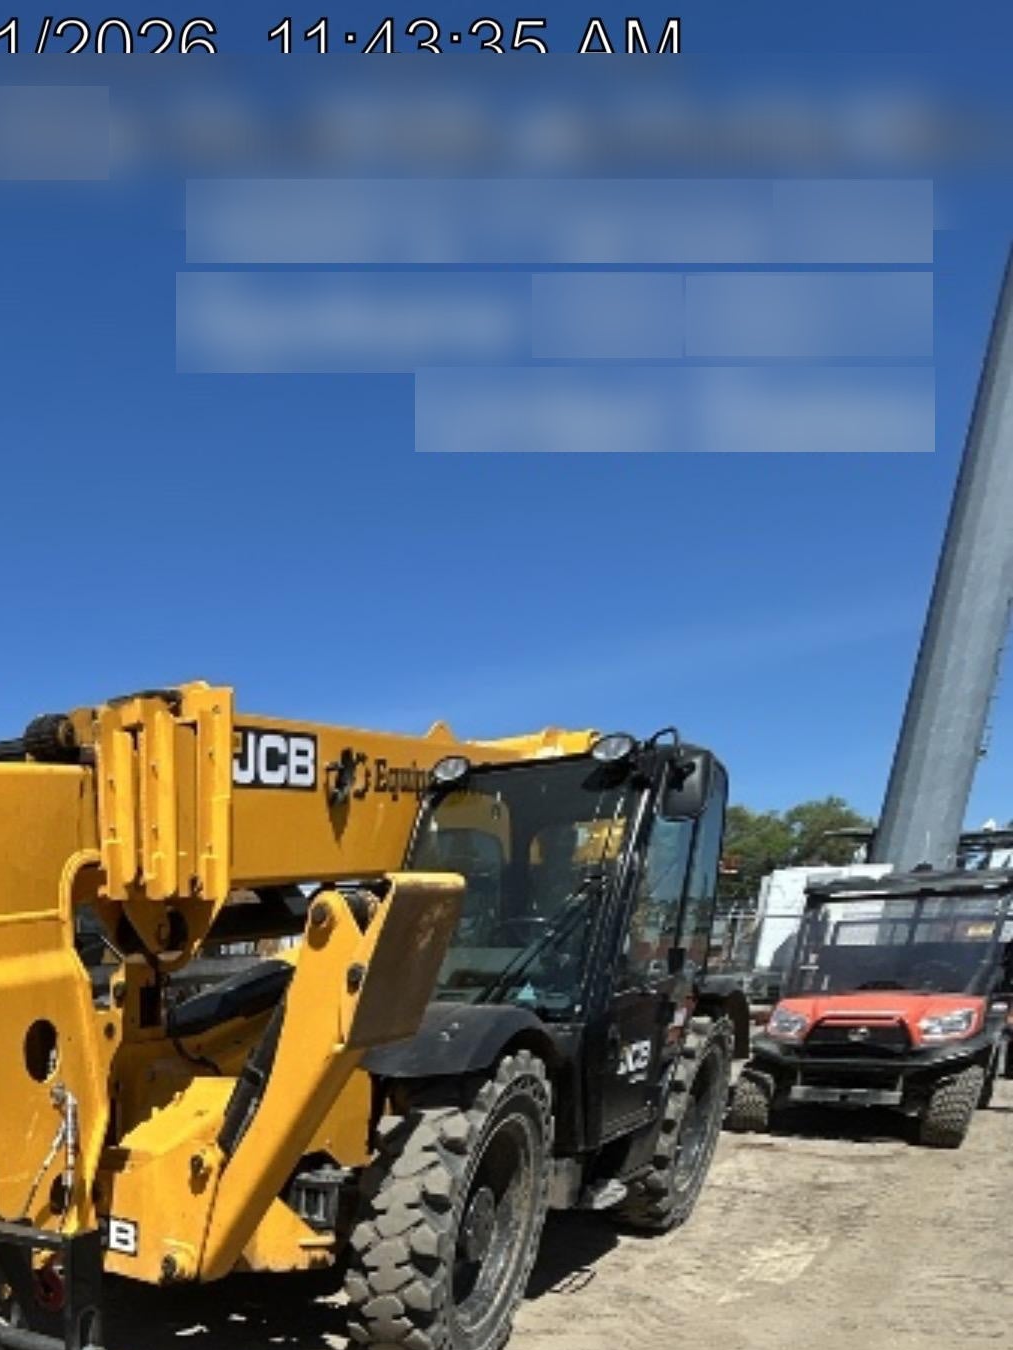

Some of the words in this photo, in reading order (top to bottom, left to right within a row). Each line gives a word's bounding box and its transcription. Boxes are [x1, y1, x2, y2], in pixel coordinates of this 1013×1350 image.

[233, 731, 315, 787] JCB
[374, 758, 429, 801] Equip
[616, 1040, 651, 1075] JCB
